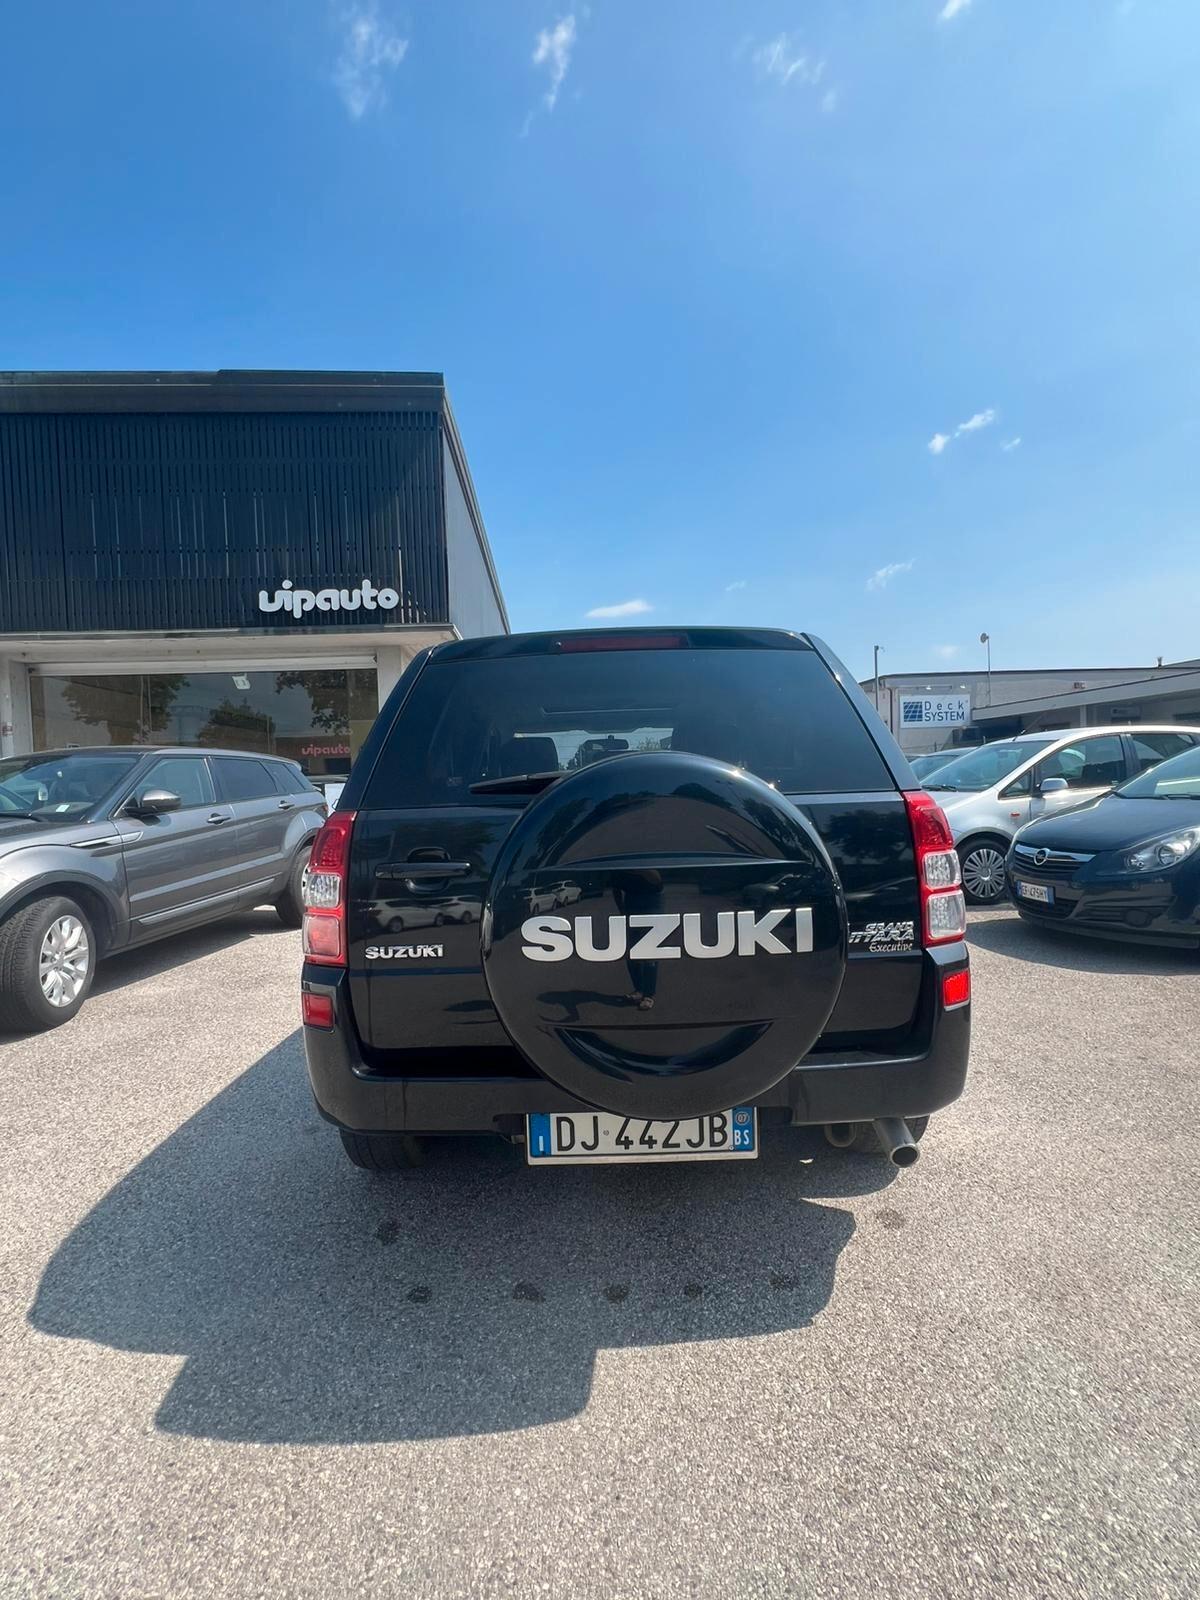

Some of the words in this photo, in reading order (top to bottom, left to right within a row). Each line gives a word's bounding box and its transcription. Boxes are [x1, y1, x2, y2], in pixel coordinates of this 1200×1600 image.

[258, 579, 399, 619] vipauto
[924, 700, 964, 711] Deck
[924, 711, 965, 722] SYSTEM
[301, 744, 351, 757] vipauto
[520, 907, 813, 962] SUZUKI
[365, 944, 443, 959] SUZUKI
[868, 939, 913, 953] Executive
[556, 1115, 599, 1151] DJ
[734, 1129, 750, 1146] BS
